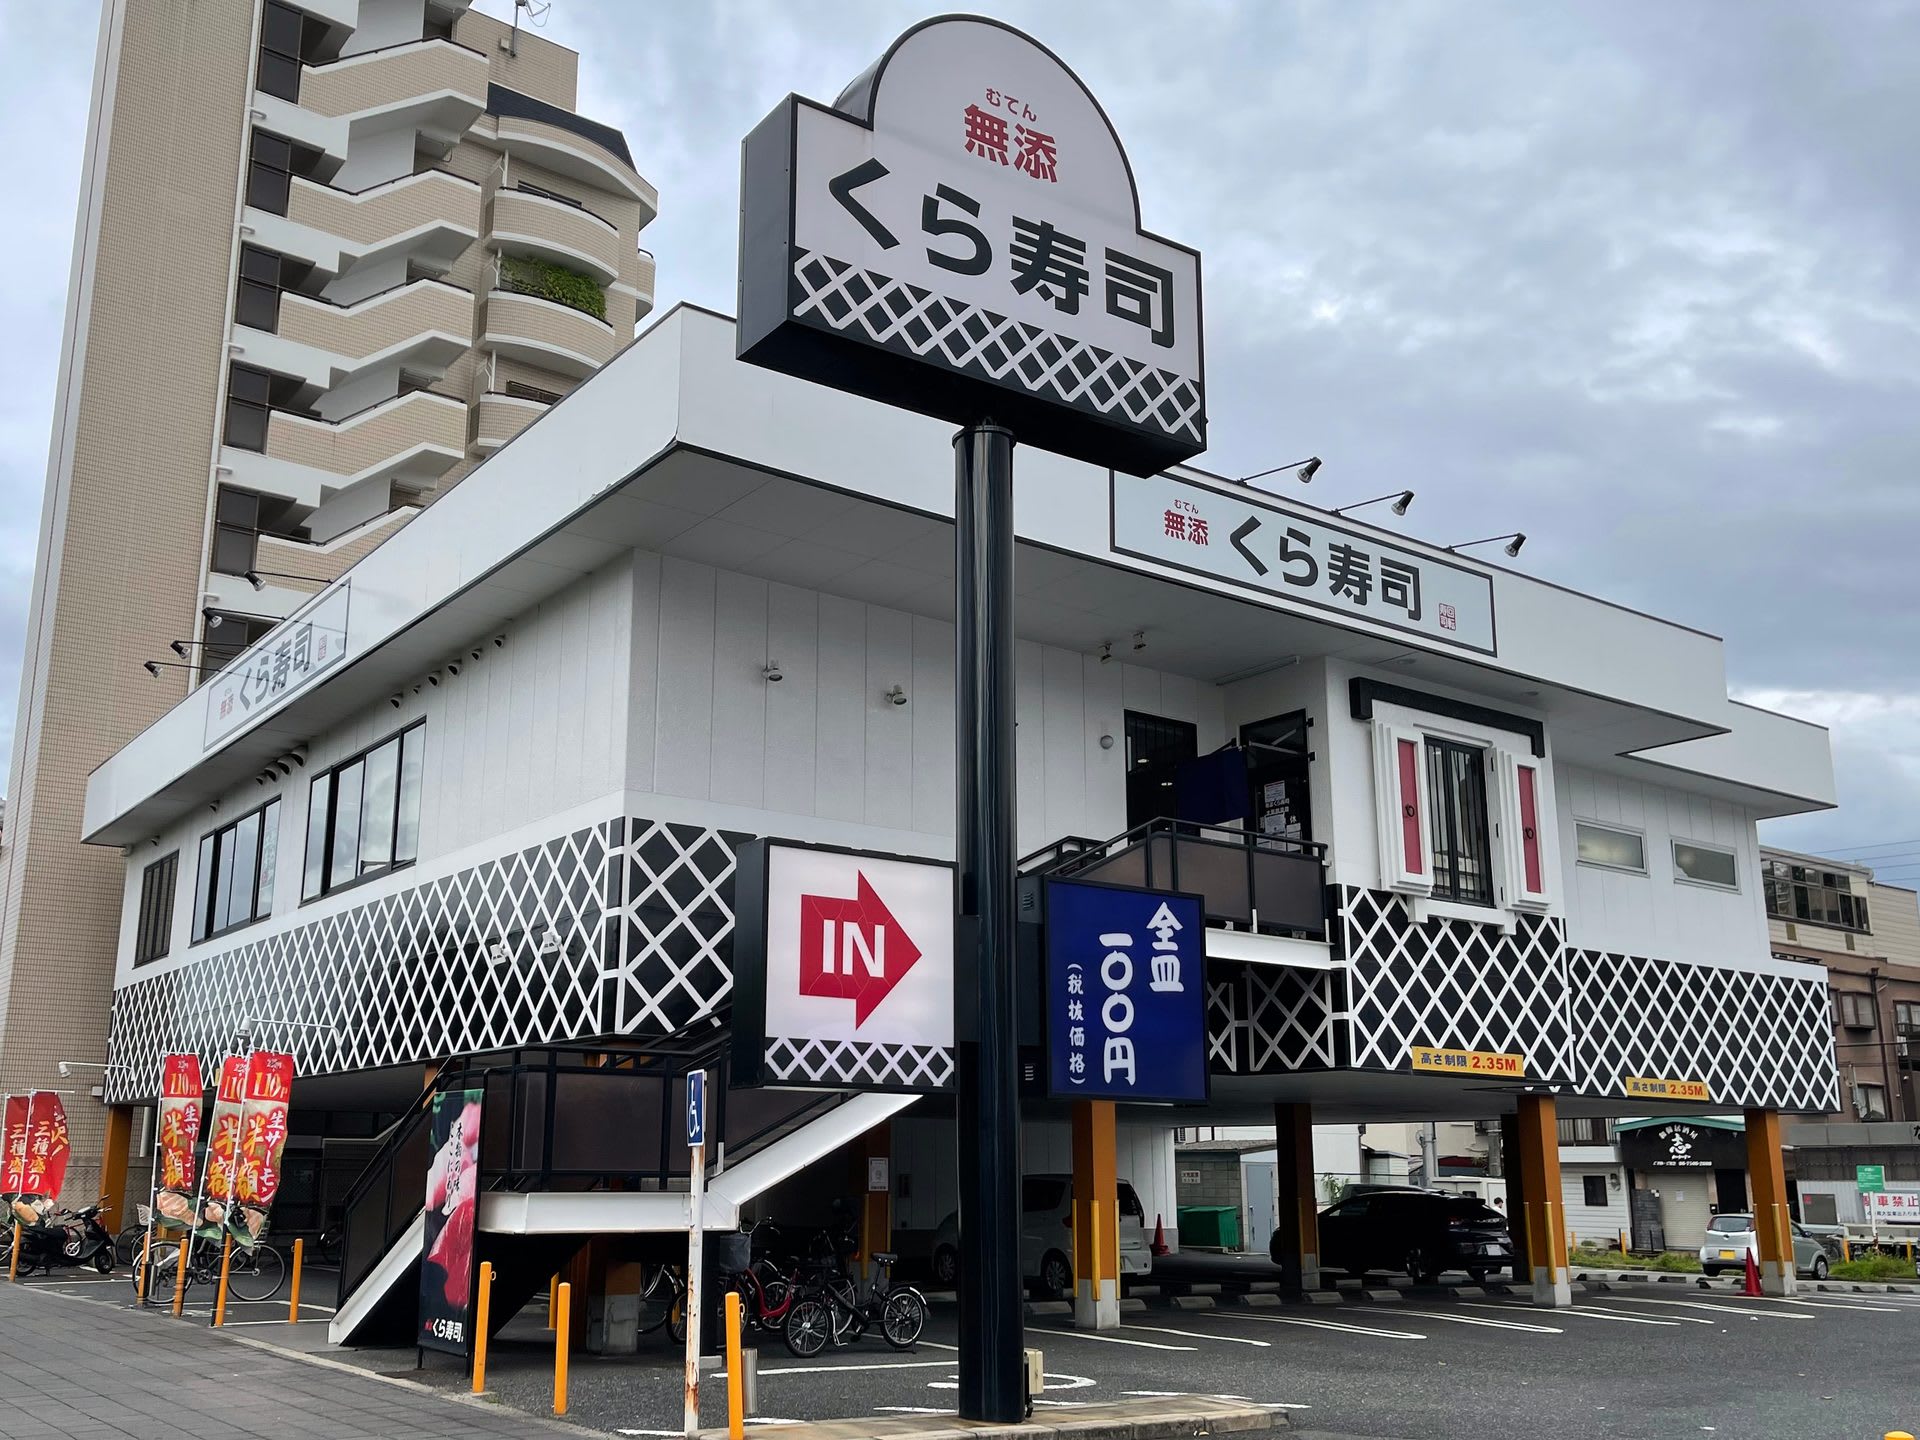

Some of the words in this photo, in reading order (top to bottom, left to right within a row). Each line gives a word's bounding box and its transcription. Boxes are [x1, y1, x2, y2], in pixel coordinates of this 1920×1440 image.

[985, 87, 1038, 122] むてん
[963, 103, 1058, 183] 無添
[828, 157, 1175, 350] くら寿司
[1163, 509, 1209, 546] 無添
[1173, 498, 1199, 514] むてん
[1229, 515, 1422, 621] くら寿司
[239, 620, 313, 711] くら寿司
[821, 919, 885, 978] IN
[1146, 901, 1185, 993] 全皿
[1420, 1052, 1467, 1068] 高さ制限
[1472, 1055, 1517, 1072] 2.35M
[1632, 1081, 1667, 1093] 高さ制限
[1670, 1084, 1703, 1096] 2.35M
[8, 1122, 26, 1190] 三種盛り
[28, 1120, 52, 1190] 三種盛り
[162, 1110, 185, 1187] 半額
[235, 1114, 265, 1201] 半額
[260, 1110, 285, 1202] 生サーモン
[432, 1317, 463, 1343] くら寿司
